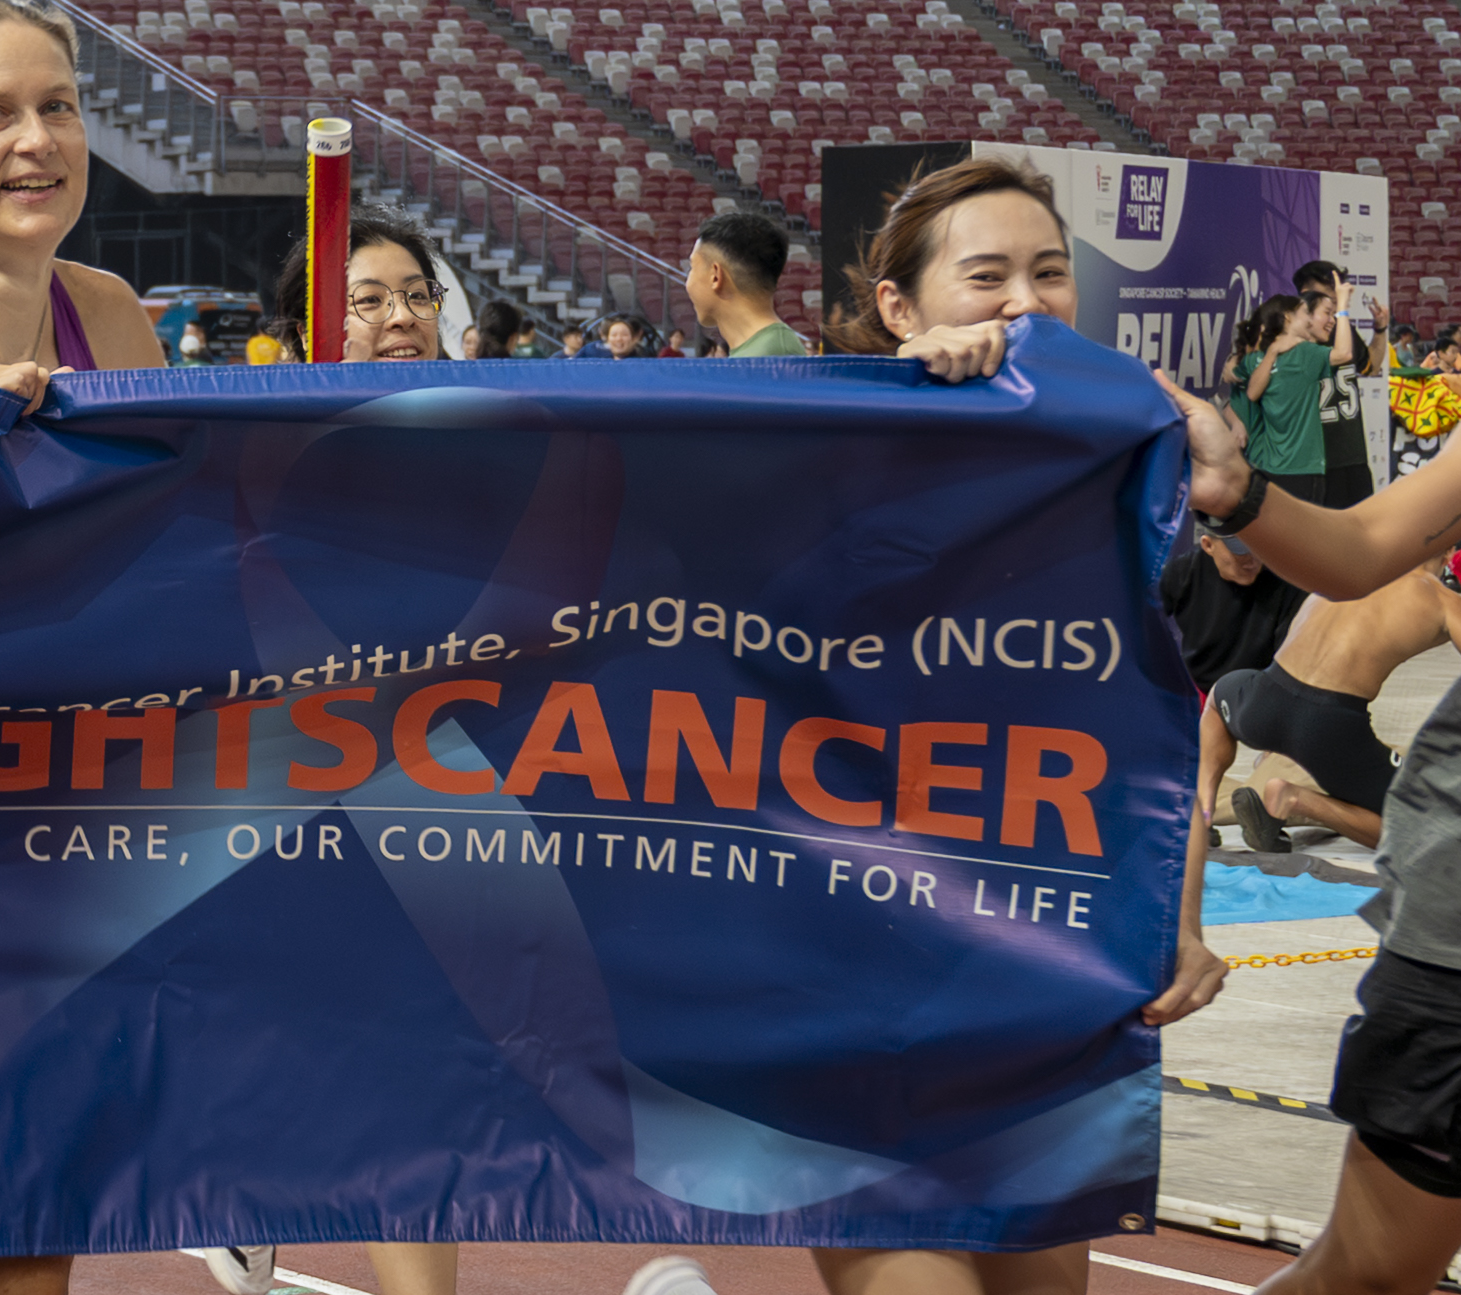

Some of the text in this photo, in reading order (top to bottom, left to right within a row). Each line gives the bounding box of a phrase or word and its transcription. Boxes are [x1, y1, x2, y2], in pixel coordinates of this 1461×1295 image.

[1130, 175, 1164, 203] RELAY
[1138, 205, 1161, 232] LIFE
[550, 596, 885, 671] Singapore
[911, 615, 1122, 681] (NCIS)
[24, 823, 190, 866] CARE,
[226, 823, 344, 861] OUR
[378, 825, 797, 887] COMMITMENT
[827, 858, 937, 909] FOR
[972, 878, 1092, 930] LIFE
